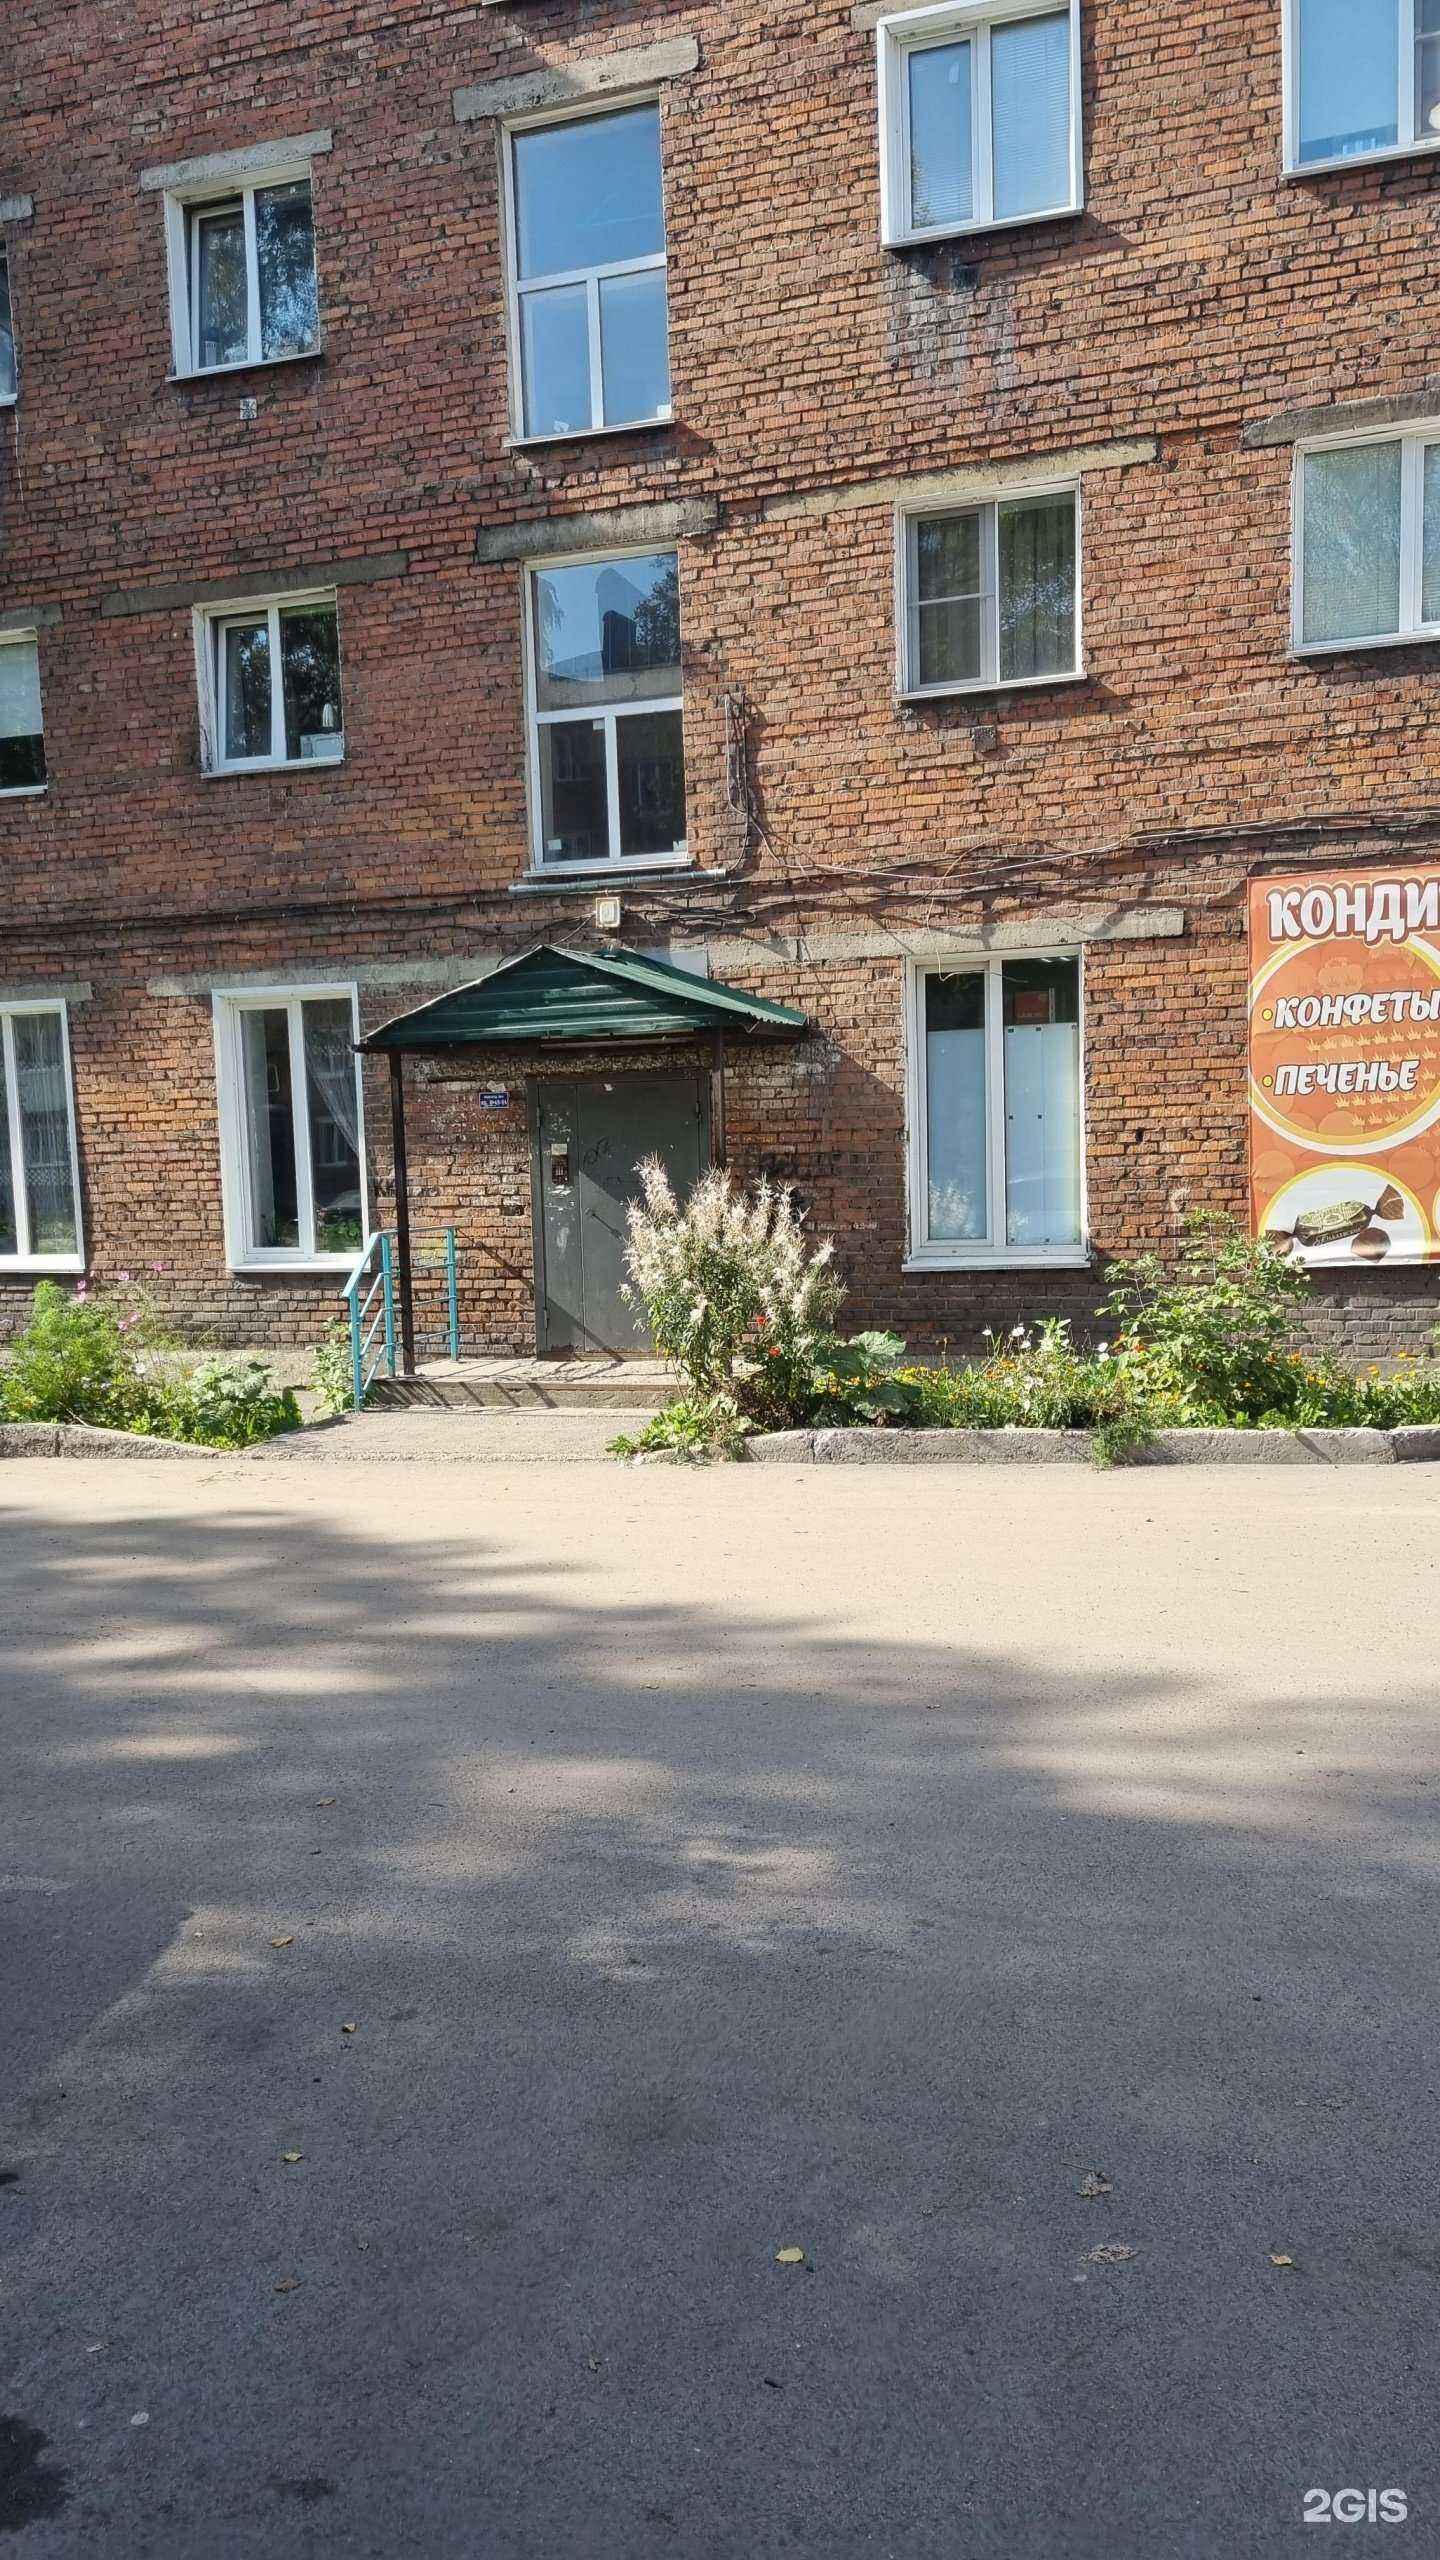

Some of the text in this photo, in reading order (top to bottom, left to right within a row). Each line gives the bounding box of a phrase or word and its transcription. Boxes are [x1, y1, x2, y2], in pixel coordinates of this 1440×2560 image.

[1267, 880, 1440, 944] КОНДИ
[1274, 989, 1440, 1029] КОНФЕТЫ
[1273, 1059, 1420, 1096] ПЕЧЕНЬЕ
